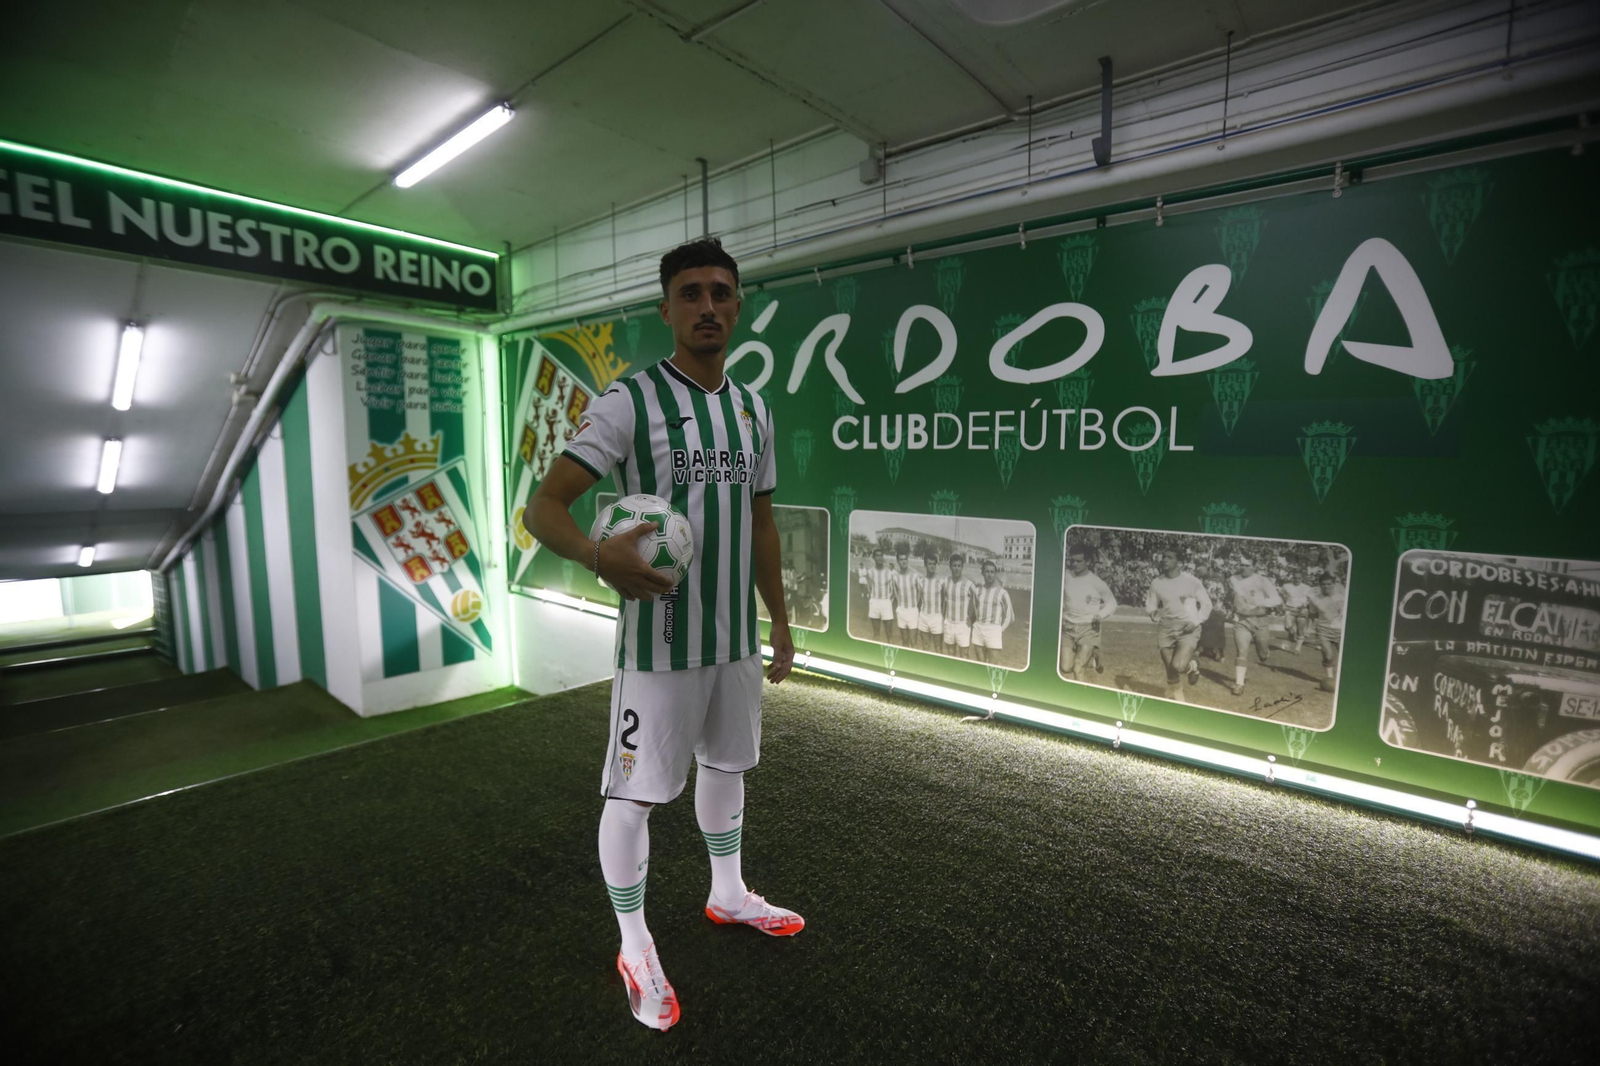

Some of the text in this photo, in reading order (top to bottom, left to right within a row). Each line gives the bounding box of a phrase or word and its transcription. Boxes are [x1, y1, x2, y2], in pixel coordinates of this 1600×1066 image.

[107, 191, 361, 274] NUESTRO
[374, 244, 493, 297] REINO
[723, 237, 1455, 405] ÓRDOBA
[396, 338, 428, 353] para
[399, 354, 429, 368] para
[397, 370, 428, 384] para
[407, 385, 438, 399] para
[396, 400, 428, 414] para
[1399, 589, 1468, 624] CON
[664, 602, 674, 643] CÓRDOBA
[620, 708, 639, 751] 2
